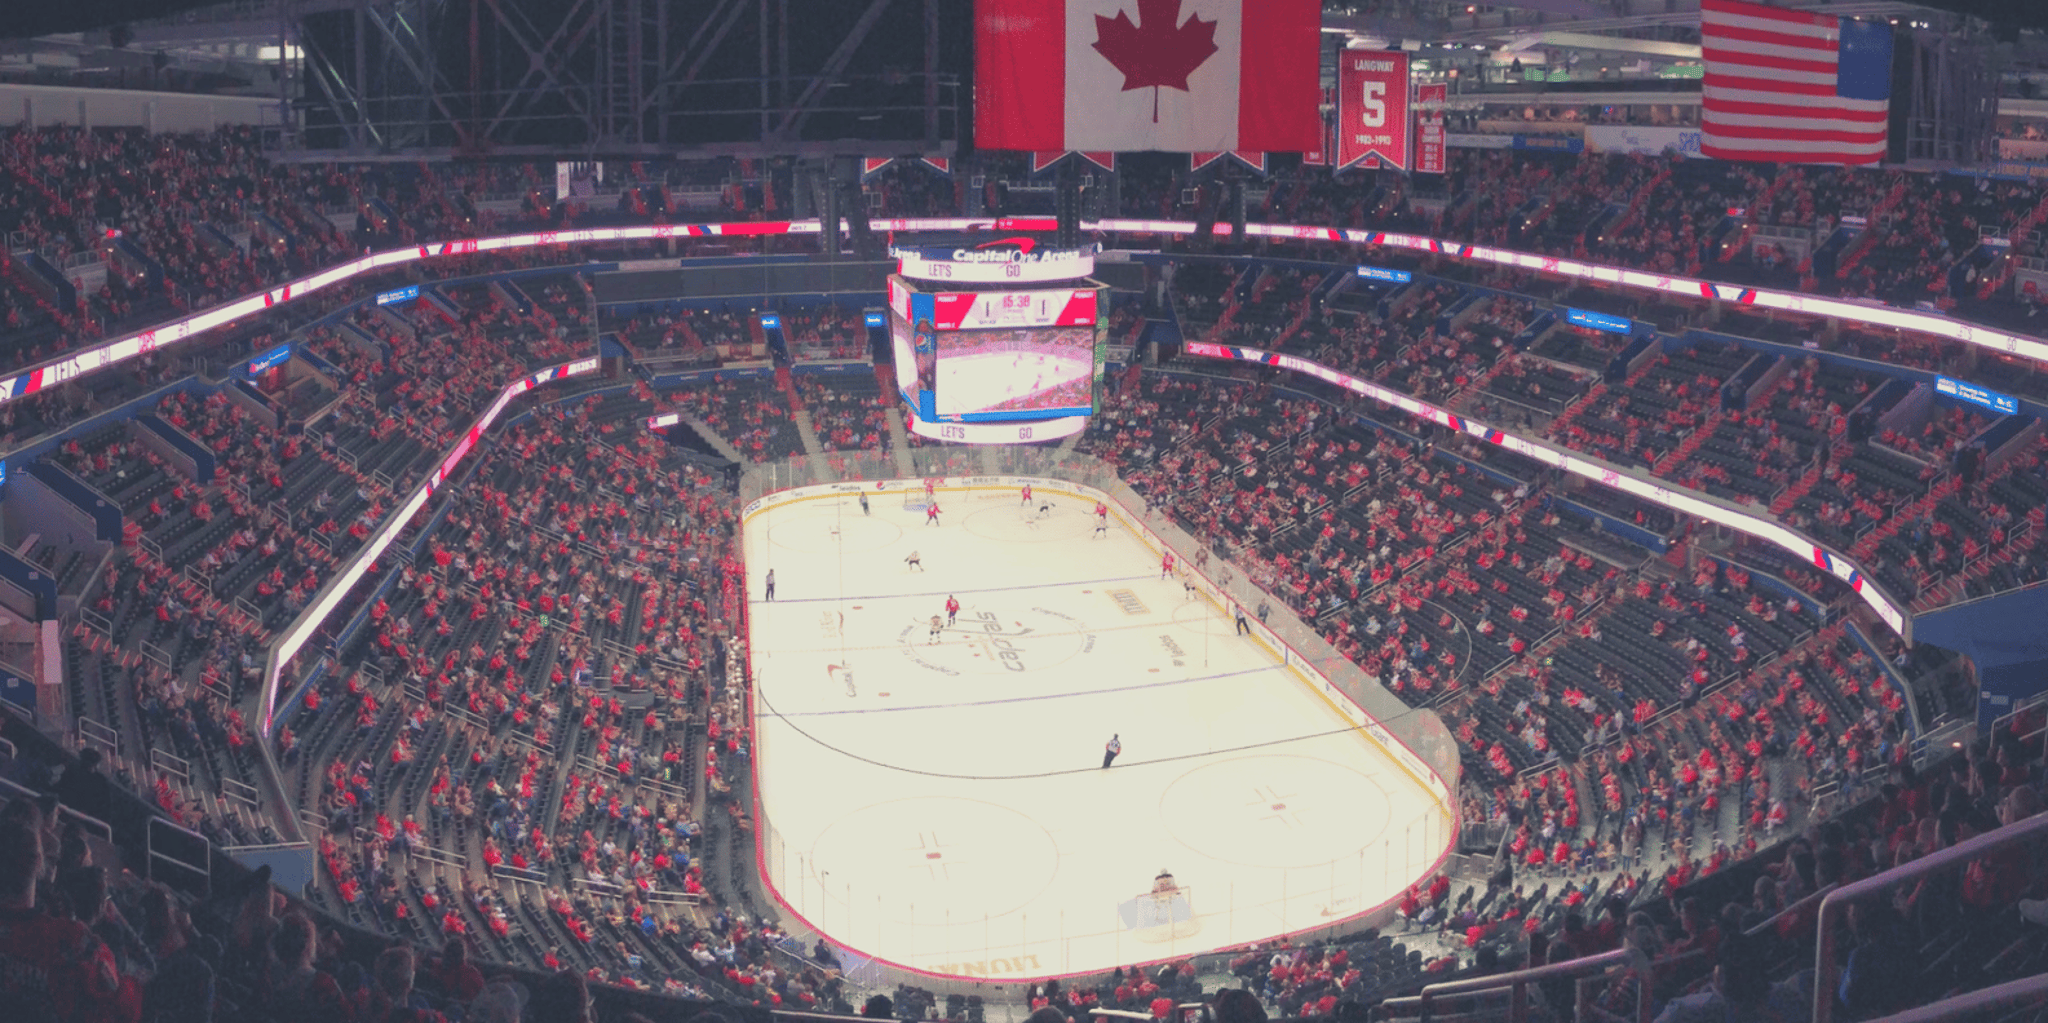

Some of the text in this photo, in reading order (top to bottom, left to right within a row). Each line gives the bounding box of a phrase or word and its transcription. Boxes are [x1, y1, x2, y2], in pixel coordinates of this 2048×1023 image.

[1355, 59, 1395, 72] LANGWAY
[1362, 81, 1386, 128] 5
[1006, 264, 1021, 277] GO
[1018, 427, 1033, 440] GO
